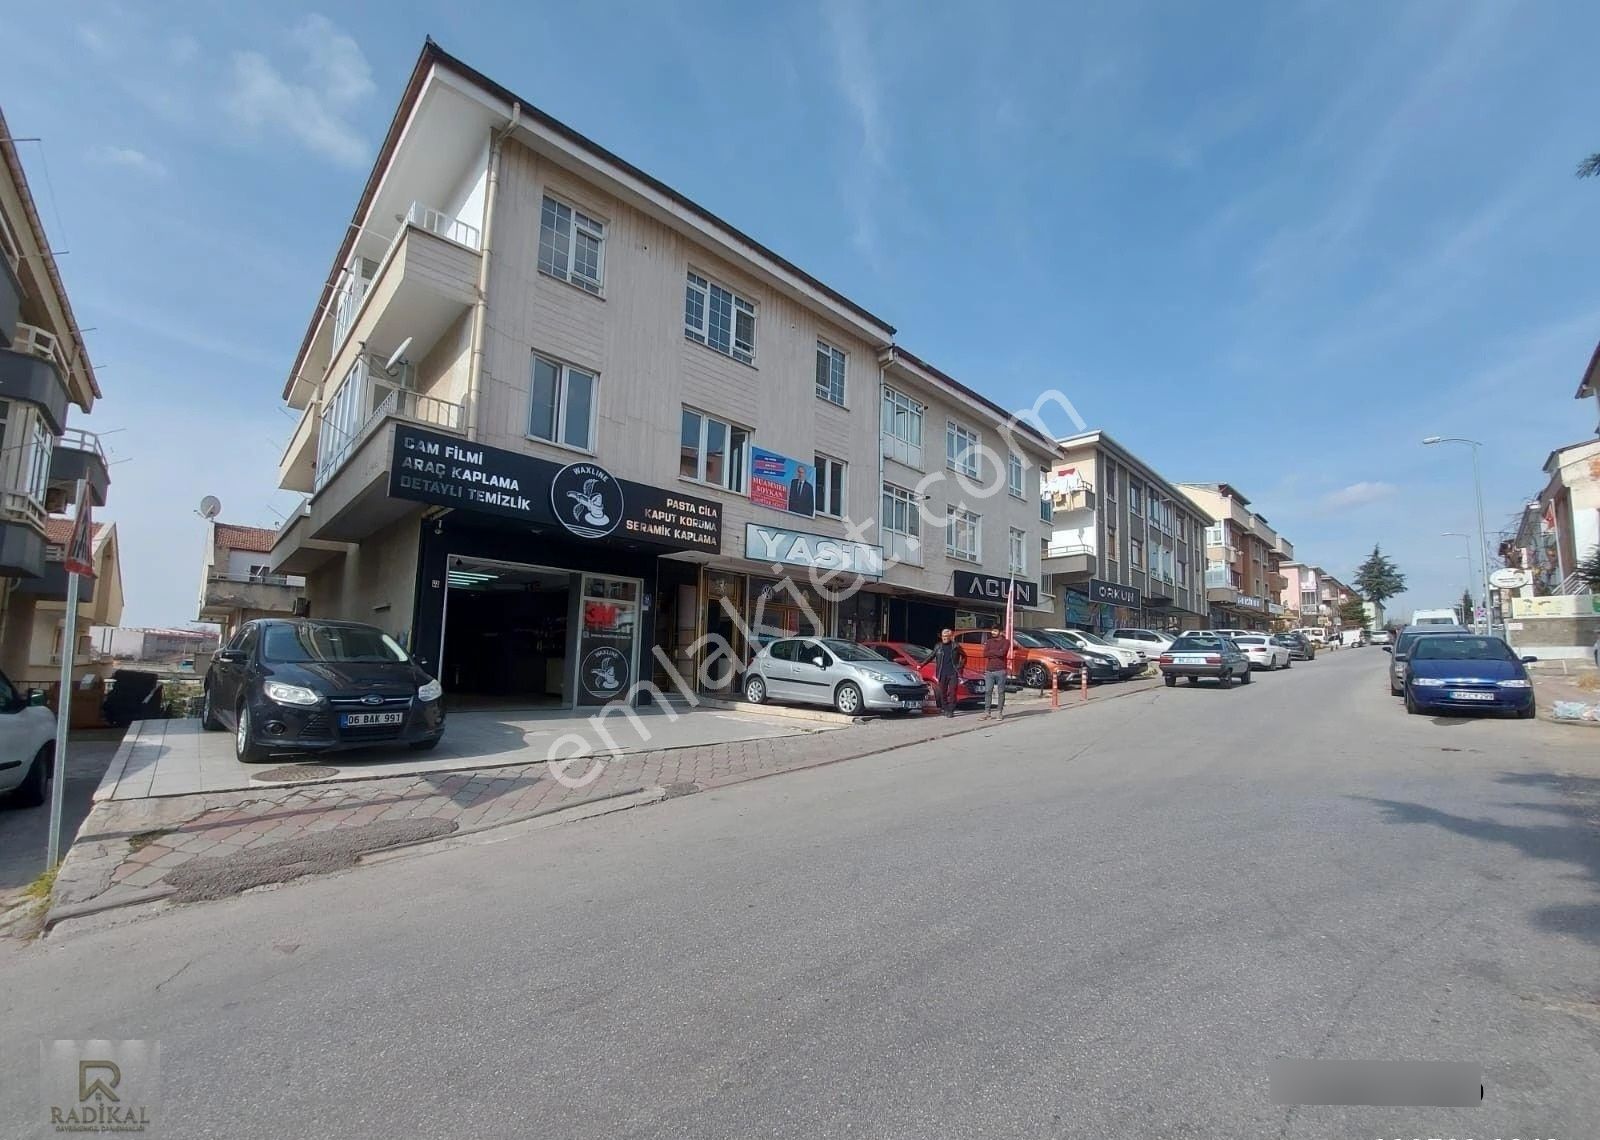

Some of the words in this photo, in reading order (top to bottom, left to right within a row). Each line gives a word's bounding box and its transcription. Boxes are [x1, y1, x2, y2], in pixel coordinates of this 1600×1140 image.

[403, 436, 439, 456] CAM
[445, 446, 483, 465] FİLMİ
[401, 456, 446, 478] ARAÇ
[451, 467, 519, 491] KAPLAMA
[572, 466, 609, 482] WAXLINE
[400, 475, 462, 498] DETAYLI
[467, 488, 531, 511] TEMİZLİK
[644, 508, 677, 523] KAPUT
[679, 515, 717, 531] KORUMA
[666, 498, 696, 513] PASTA
[698, 505, 718, 518] CİLA
[626, 519, 671, 537] SERAMİK
[674, 529, 717, 545] KAPLAMA
[1099, 586, 1134, 602] ORKUN
[348, 716, 360, 724] 06
[363, 715, 380, 723] BAK
[384, 714, 400, 722] 991
